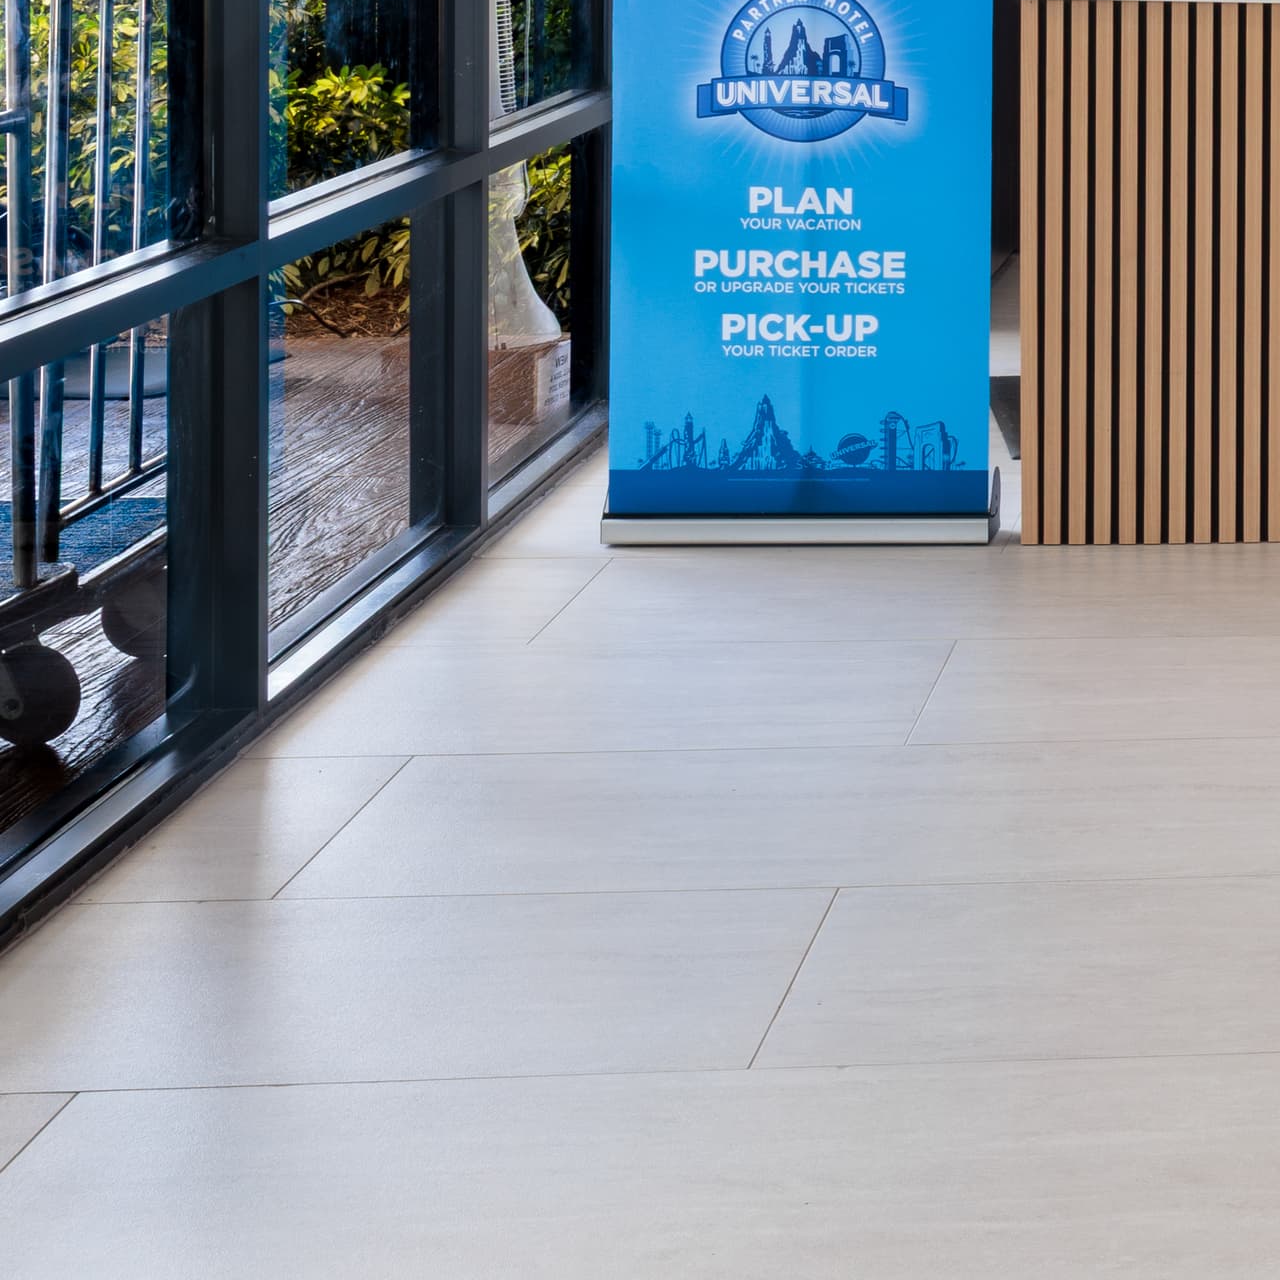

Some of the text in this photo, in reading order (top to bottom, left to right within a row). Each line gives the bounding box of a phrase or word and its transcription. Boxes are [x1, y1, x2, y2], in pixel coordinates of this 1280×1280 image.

[716, 80, 889, 109] UNIVERSAL
[749, 186, 853, 215] PLAN
[740, 218, 862, 231] YOUR VACATION
[694, 250, 906, 279] PURCHASE
[694, 281, 905, 295] OR UPGRADE YOUR TICKETS
[721, 313, 879, 342] PICK-UP
[722, 345, 877, 358] YOUR TICKET ORDER
[831, 439, 878, 460] UNIVERSAL
